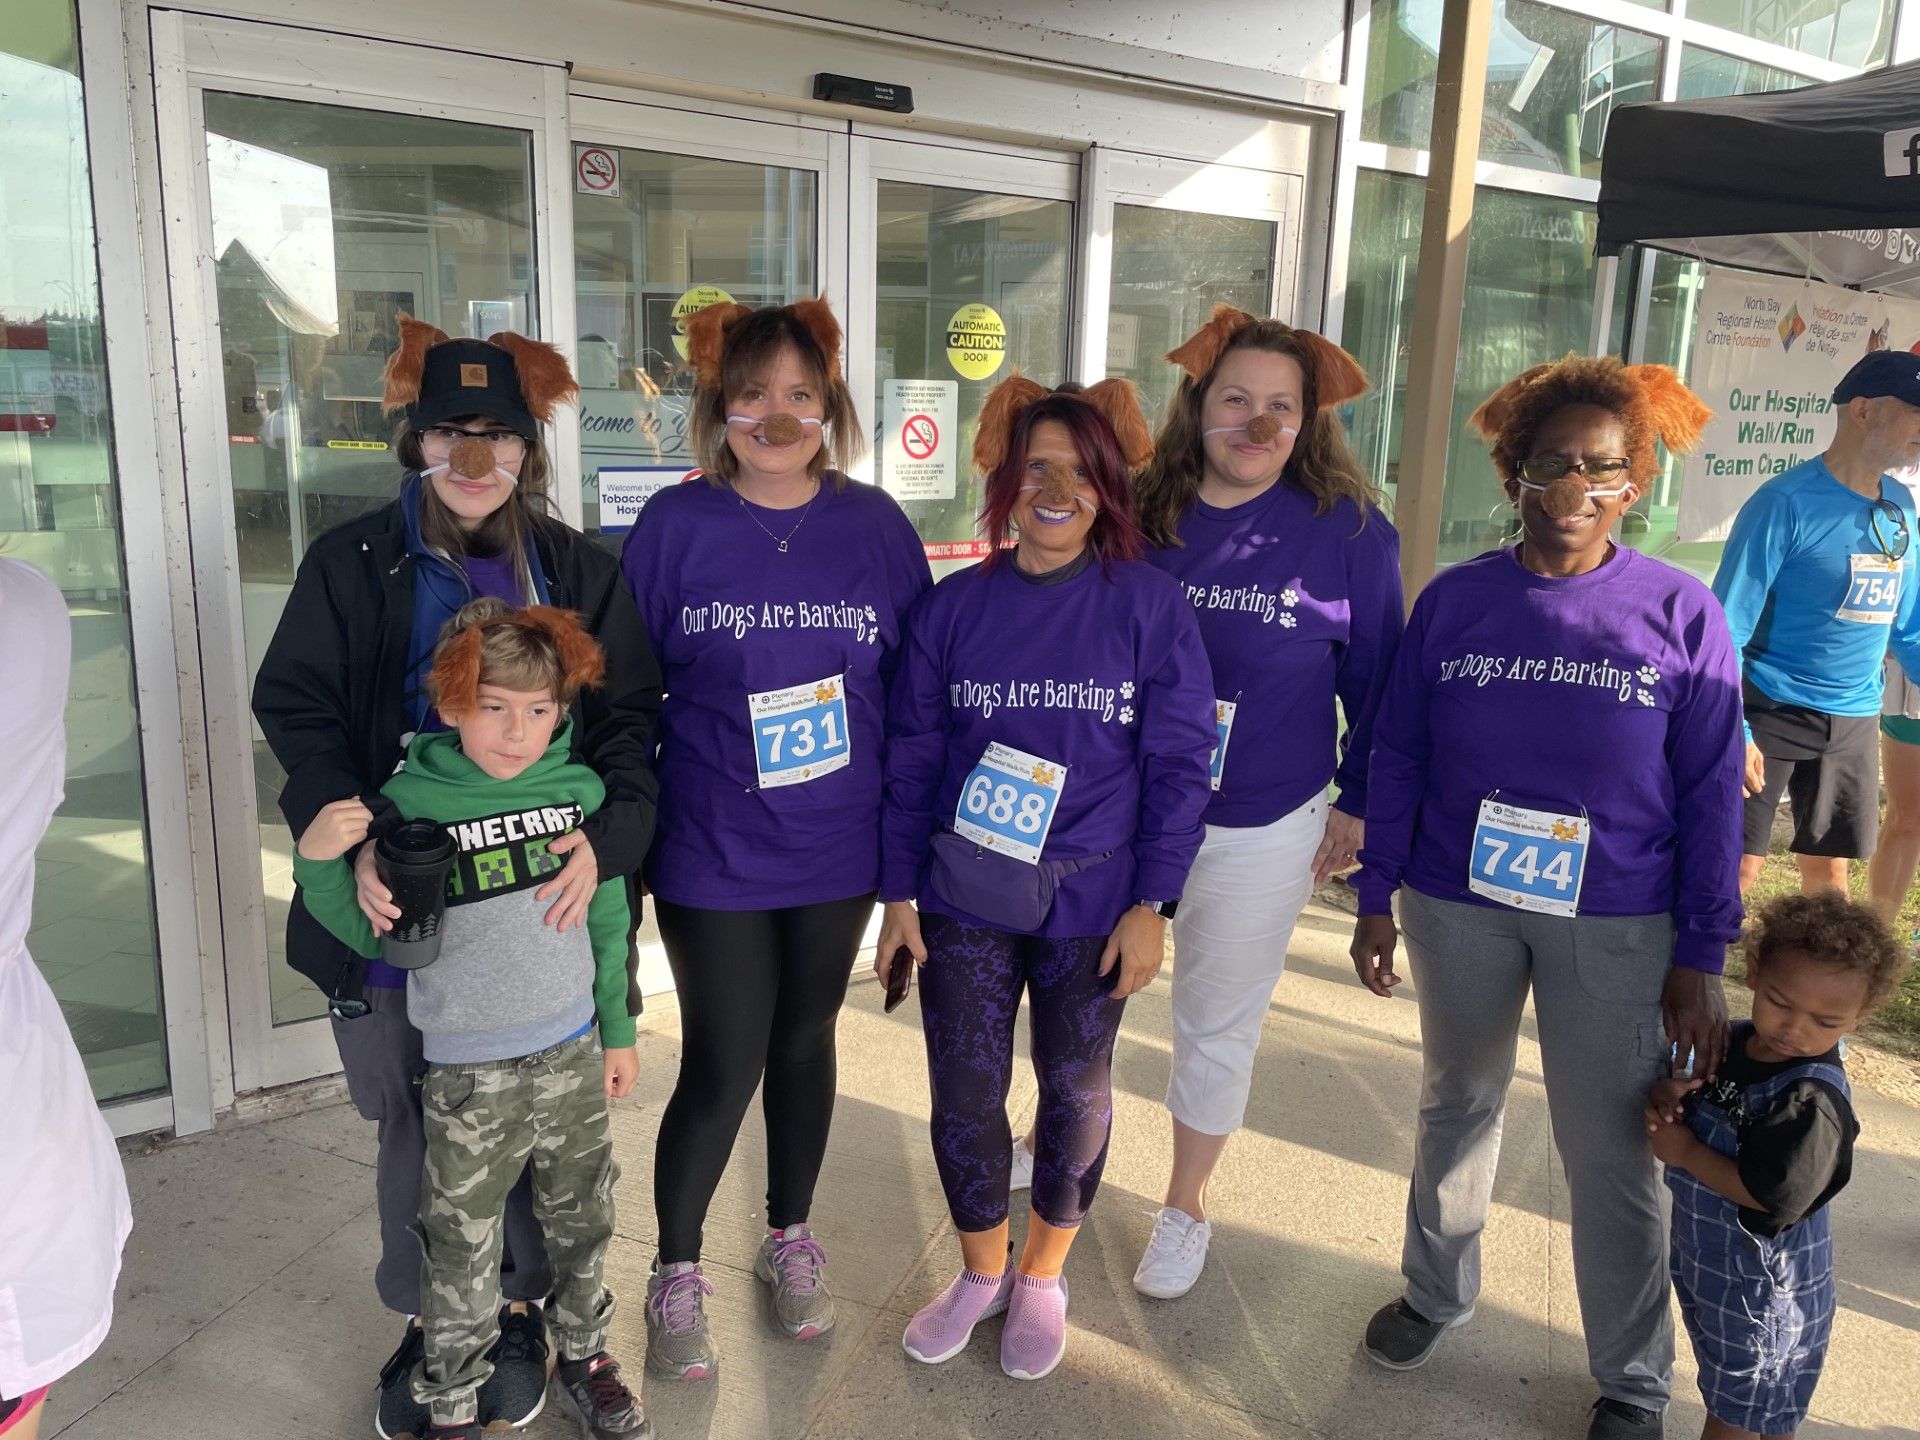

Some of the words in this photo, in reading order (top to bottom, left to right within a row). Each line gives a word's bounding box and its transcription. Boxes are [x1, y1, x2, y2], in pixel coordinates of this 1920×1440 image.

[1744, 296, 1767, 312] North
[1768, 299, 1782, 315] Bay
[953, 320, 1001, 331] AUTOMATIC
[1717, 312, 1752, 330] Regional
[1753, 316, 1777, 331] Health
[950, 334, 1003, 349] CAUTION
[1806, 339, 1816, 352] de
[963, 352, 989, 362] DOOR
[1729, 388, 1761, 412] Our
[1765, 390, 1834, 419] Hospital
[1738, 421, 1815, 444] Walk/Run
[1705, 453, 1753, 476] Team
[953, 543, 972, 554] DOOR
[1181, 581, 1206, 608] re
[1207, 584, 1277, 623] Barking
[1853, 578, 1896, 606] 754
[683, 606, 708, 635] Our
[712, 602, 756, 640] Dogs
[761, 602, 795, 628] Are
[799, 600, 866, 642] Barking
[1459, 653, 1505, 687] Dogs
[1506, 656, 1547, 681] Are
[1549, 656, 1632, 702] Barking
[963, 680, 1002, 719] Dogs
[1006, 680, 1040, 707] Are
[1044, 678, 1115, 723] Barking
[762, 710, 843, 764] 731
[966, 775, 1046, 834] 688
[1504, 807, 1528, 819] Plenary
[1496, 818, 1520, 828] Hospital
[1521, 824, 1550, 833] Walk/Run
[1482, 836, 1573, 891] 744
